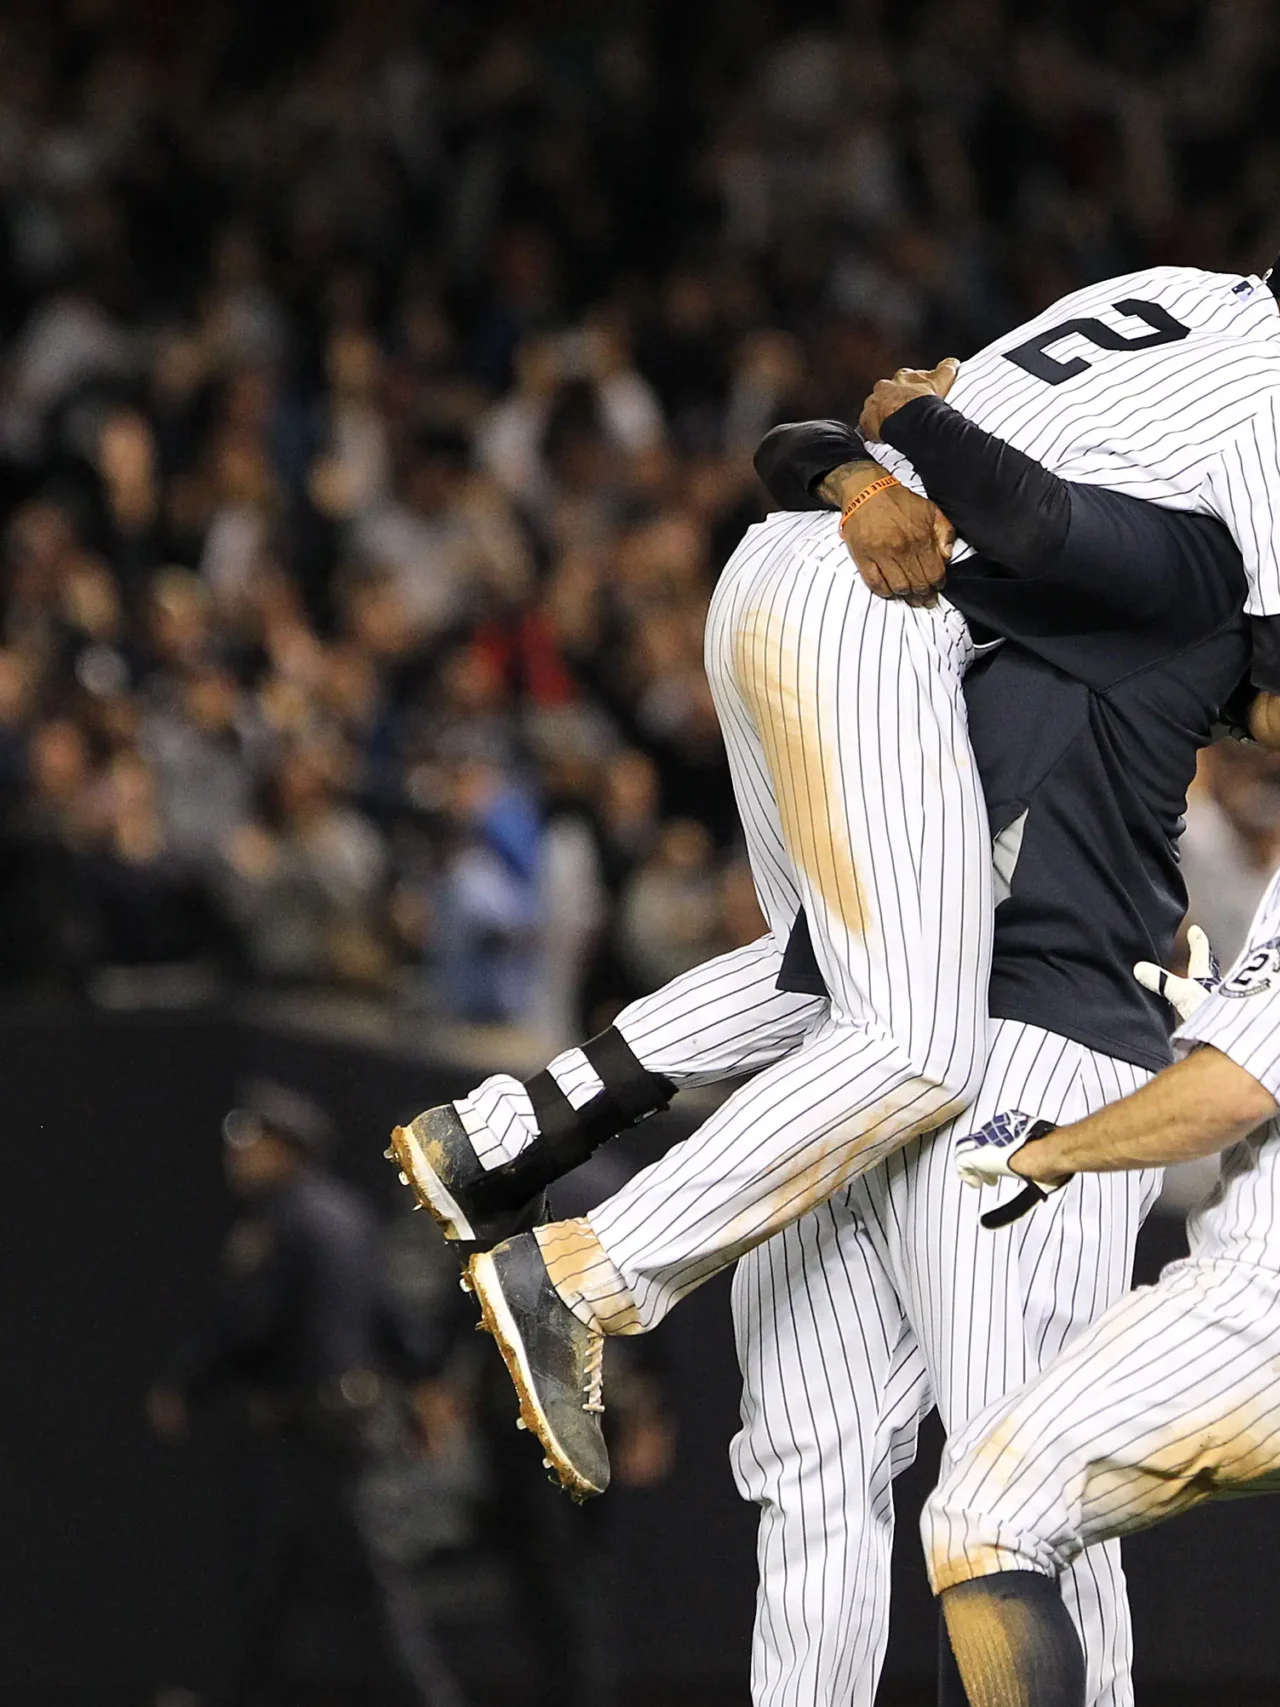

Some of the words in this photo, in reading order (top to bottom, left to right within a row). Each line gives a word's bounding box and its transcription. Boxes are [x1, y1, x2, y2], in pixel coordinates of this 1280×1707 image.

[1001, 299, 1191, 386] 2
[870, 476, 896, 491] LITTLE
[1232, 953, 1269, 985] 2
